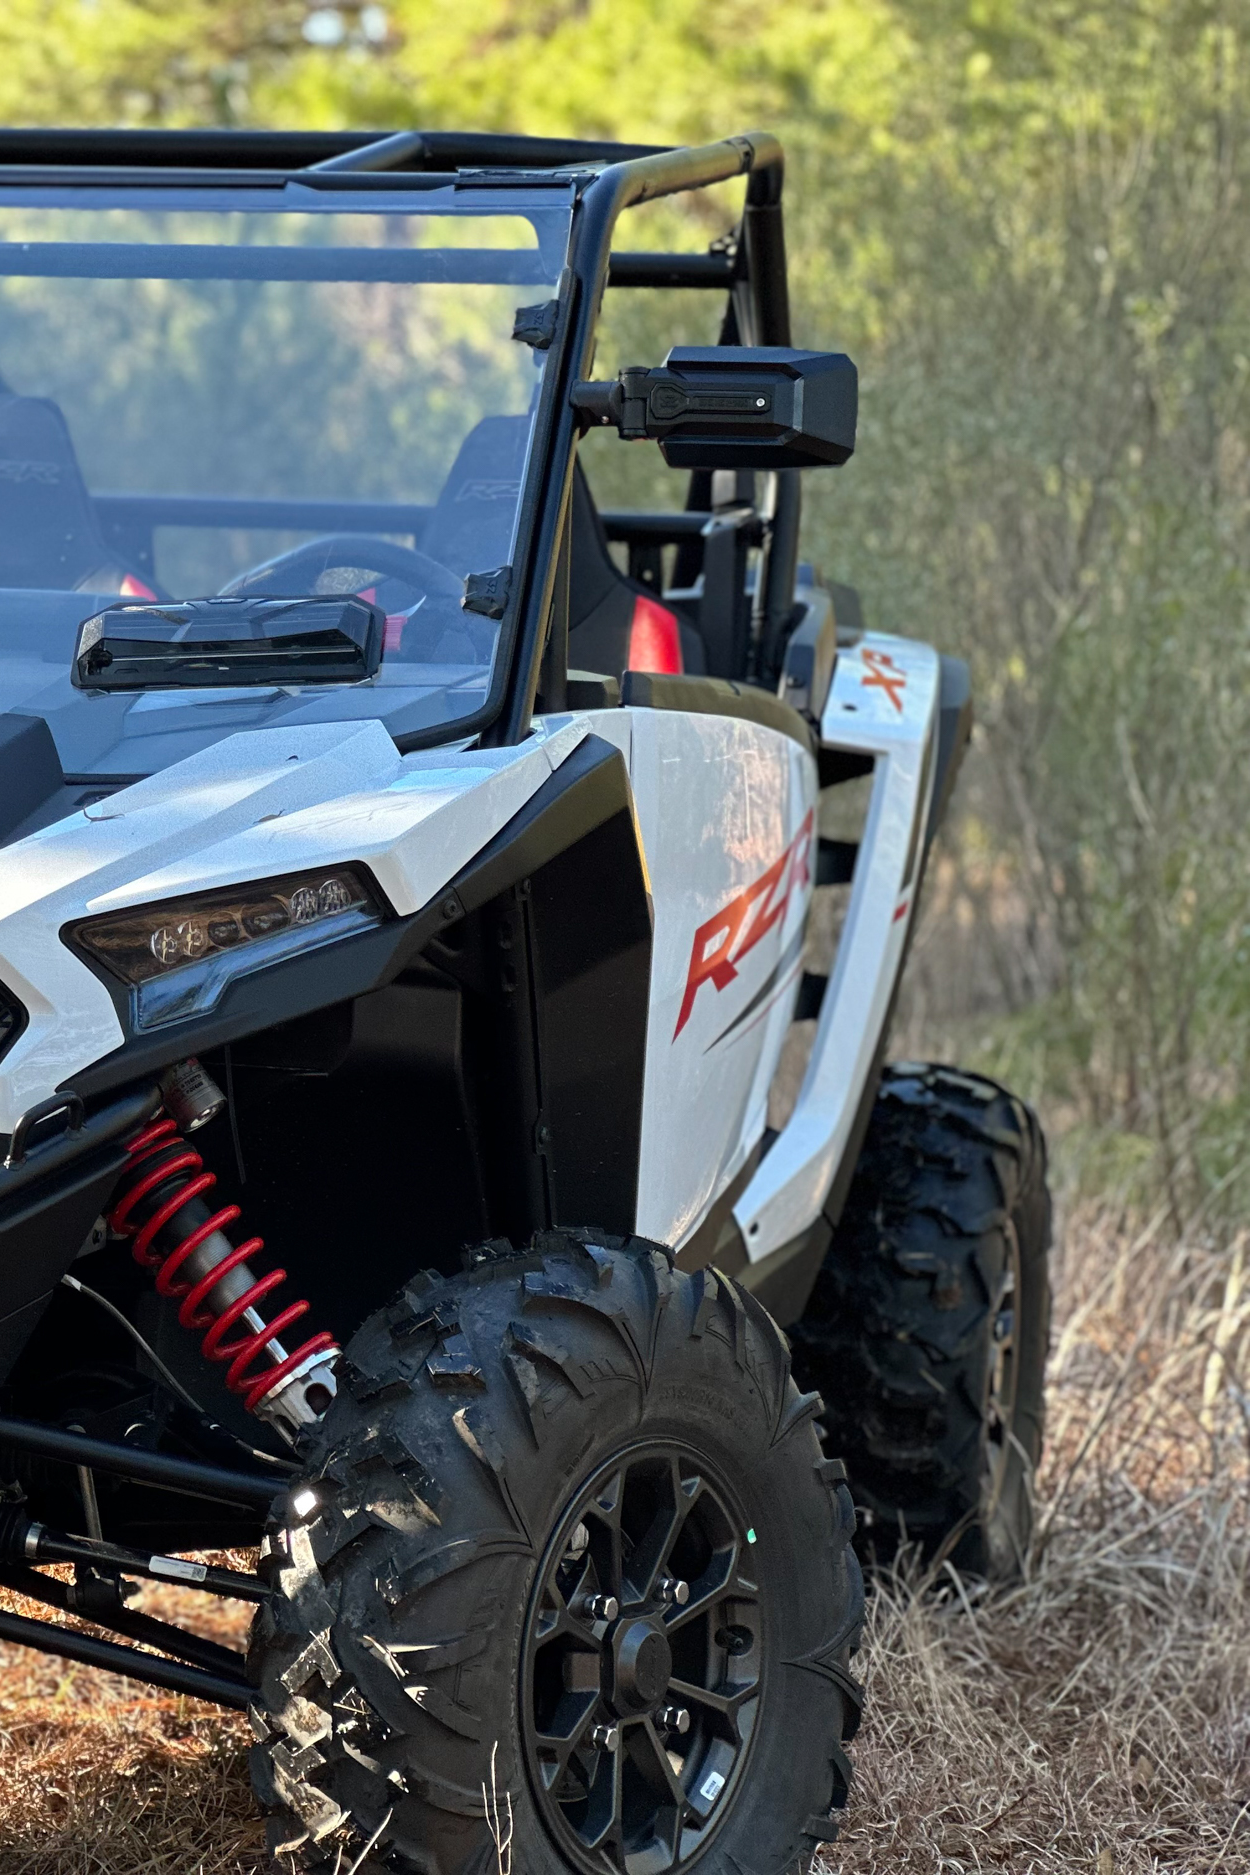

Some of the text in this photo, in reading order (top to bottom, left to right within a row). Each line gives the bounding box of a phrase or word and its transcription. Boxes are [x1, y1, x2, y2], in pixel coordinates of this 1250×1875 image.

[454, 480, 521, 501] RZ
[861, 648, 906, 714] XP
[671, 808, 815, 1046] RZR
